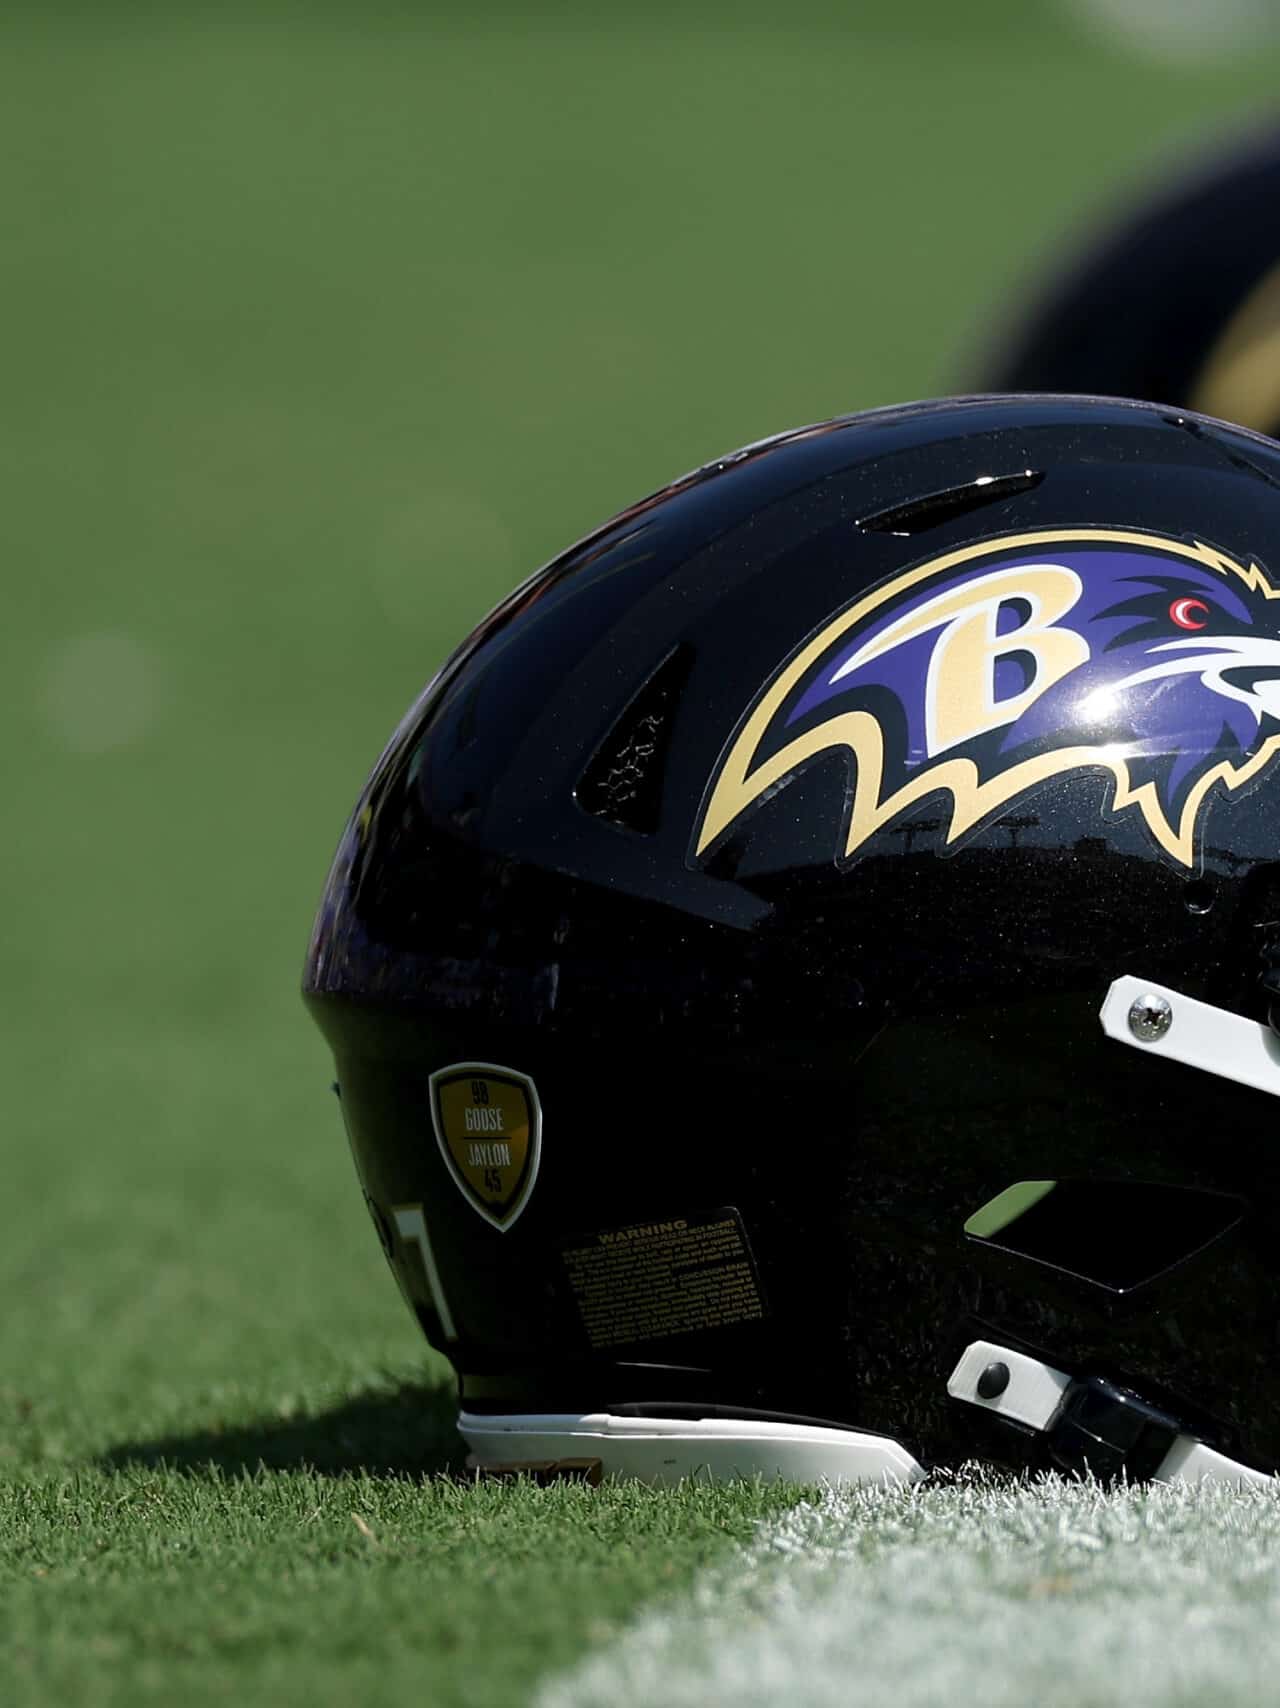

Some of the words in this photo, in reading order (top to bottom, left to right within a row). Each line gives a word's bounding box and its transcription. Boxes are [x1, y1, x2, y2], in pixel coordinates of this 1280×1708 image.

[828, 563, 1091, 760] B
[472, 1080, 490, 1105] 98
[465, 1107, 505, 1131] GOOSE
[468, 1144, 512, 1167] JAYLON
[484, 1169, 502, 1193] 45
[598, 1219, 688, 1244] WARNING
